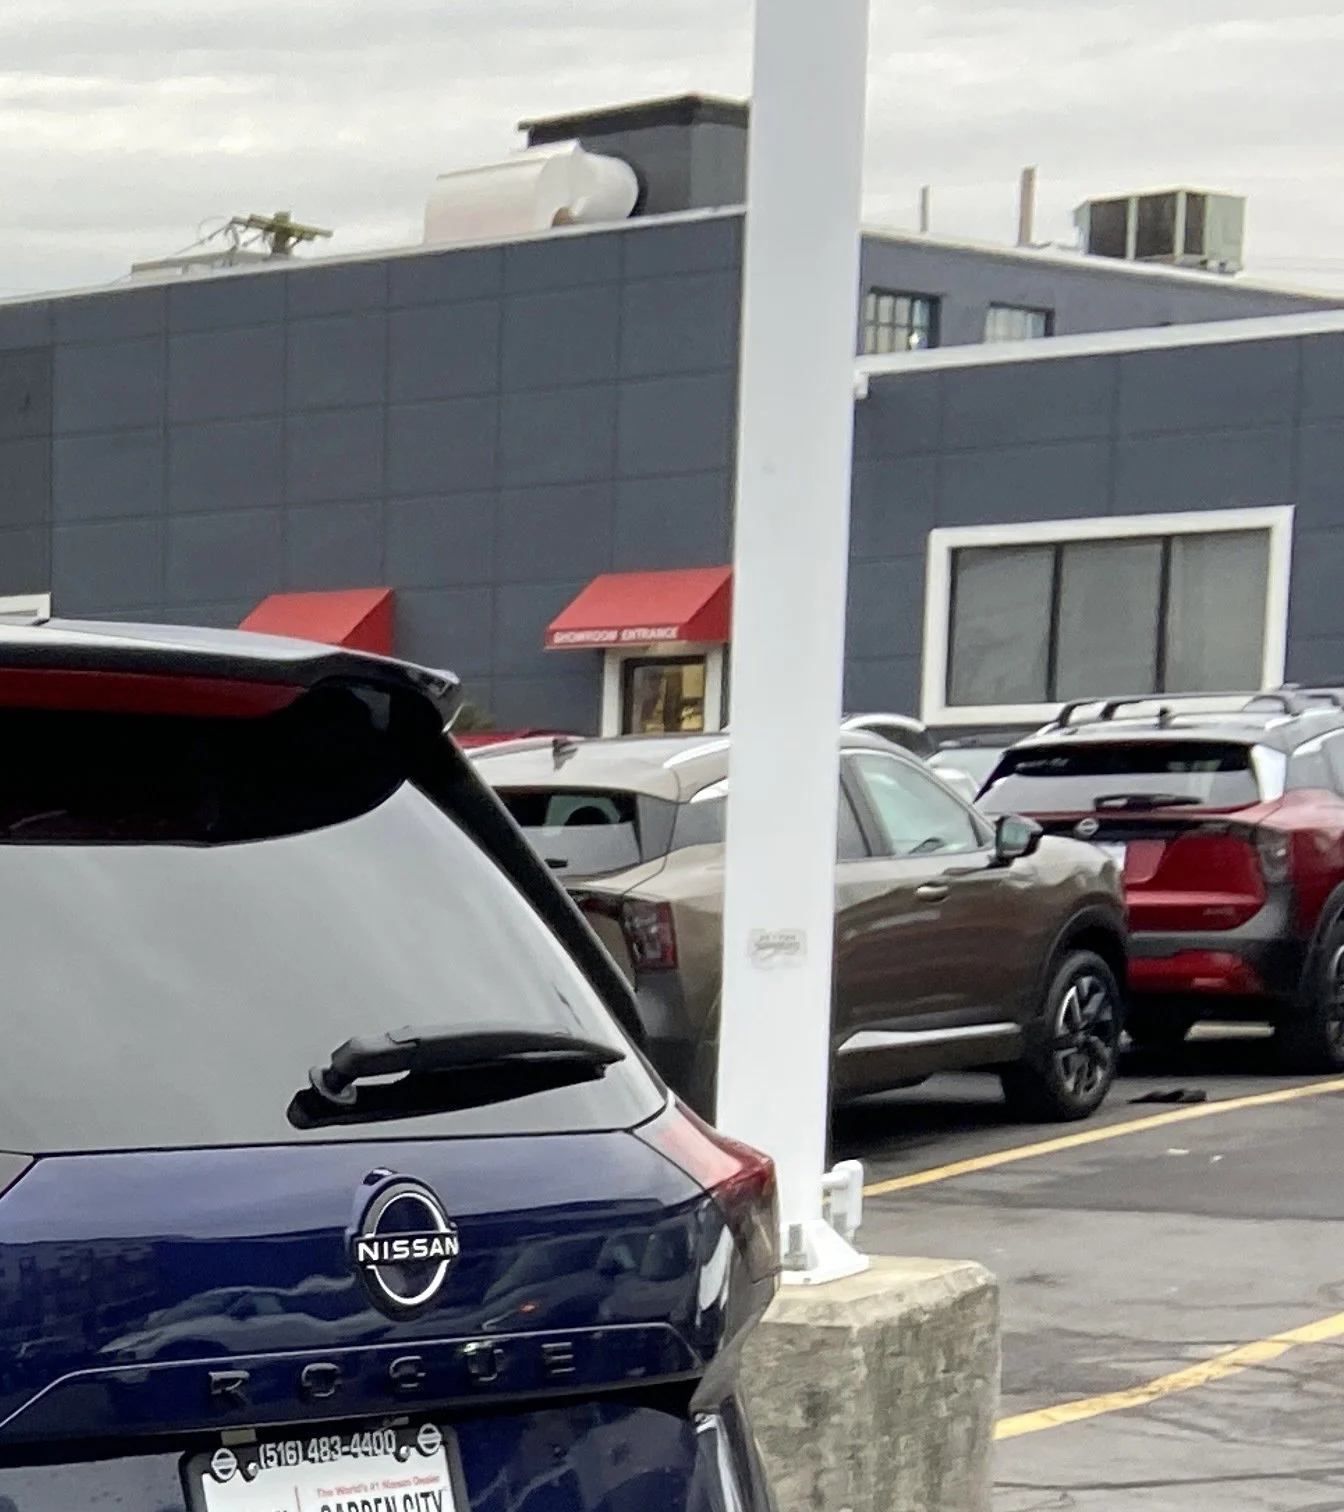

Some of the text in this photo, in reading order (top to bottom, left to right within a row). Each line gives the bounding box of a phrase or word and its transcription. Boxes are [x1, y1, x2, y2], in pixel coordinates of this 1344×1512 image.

[621, 627, 679, 640] ENTRANCE
[358, 1237, 459, 1261] NISSAN
[259, 1429, 396, 1466] (516) 483-4400
